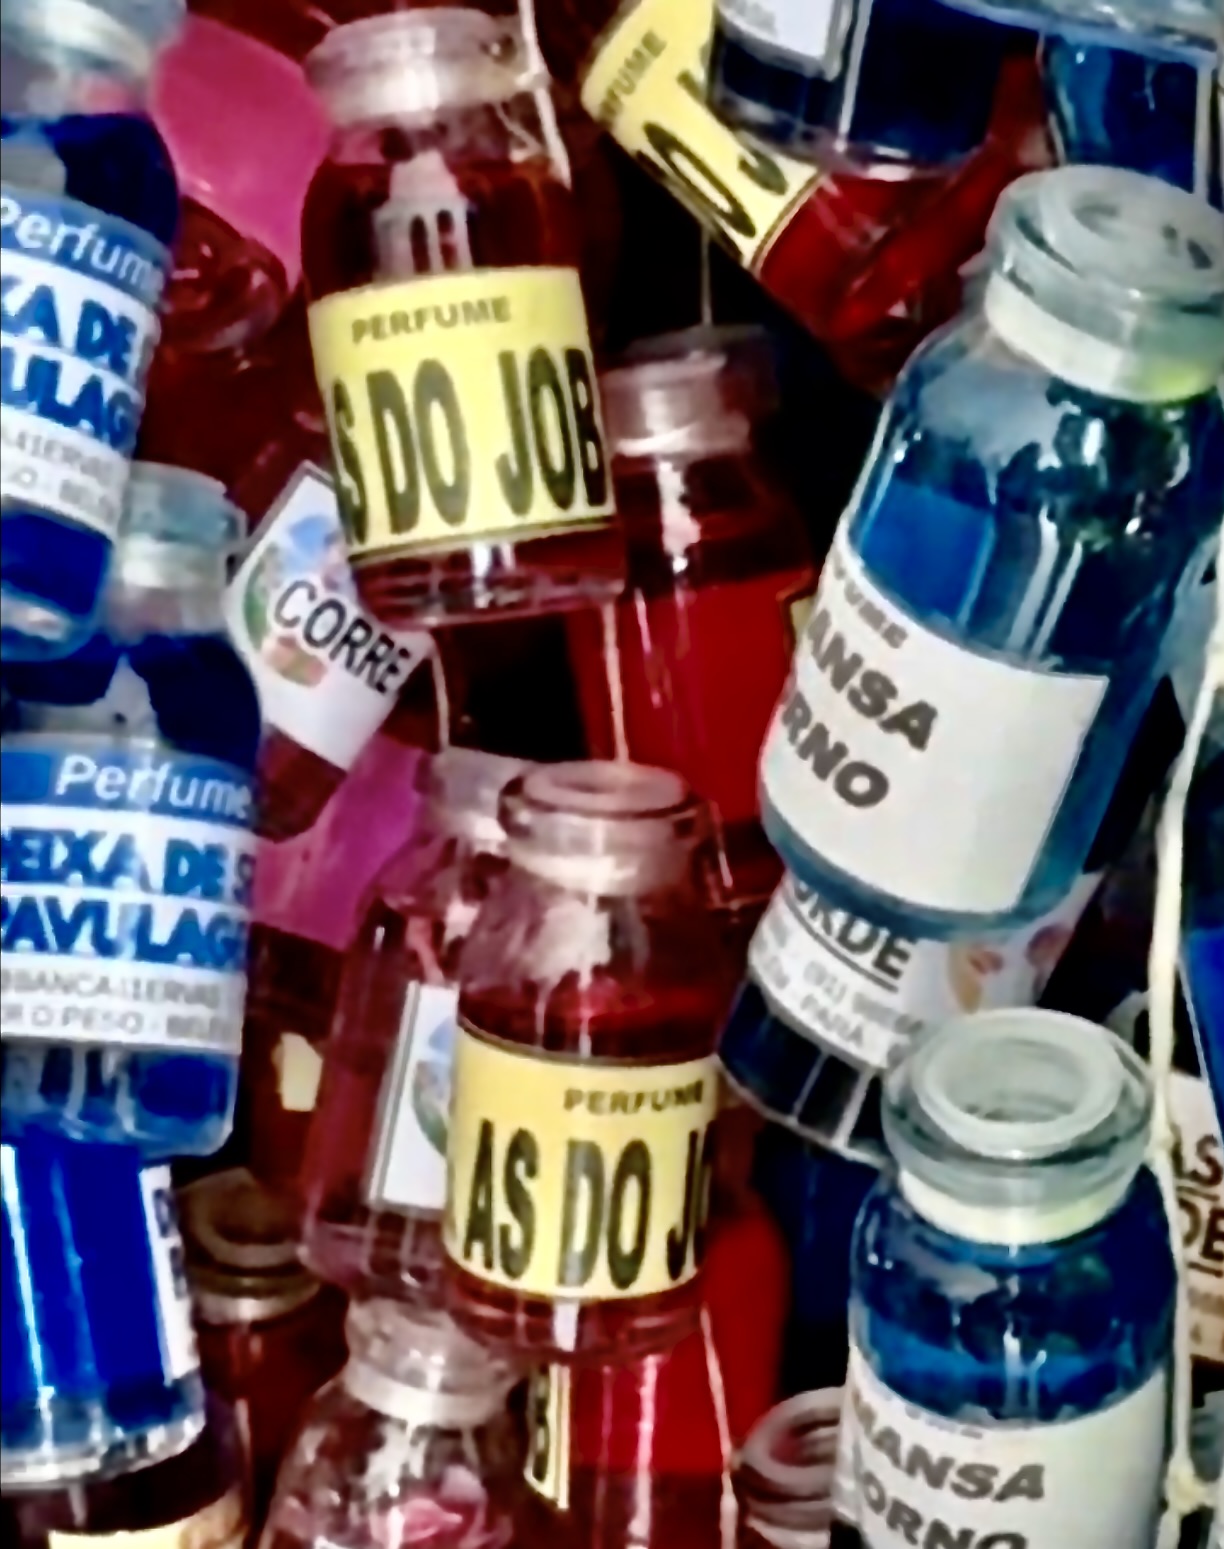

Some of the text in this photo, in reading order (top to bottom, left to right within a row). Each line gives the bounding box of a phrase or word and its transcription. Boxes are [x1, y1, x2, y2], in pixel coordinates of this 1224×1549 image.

[77, 299, 138, 378] DE
[352, 296, 512, 344] PERFUME
[366, 358, 471, 536] DO
[495, 345, 608, 518] JOB
[274, 579, 410, 695] CORRE
[0, 826, 153, 895] EIXA
[164, 837, 228, 898] DE
[0, 895, 246, 971] AVULAG
[464, 1118, 540, 1280] AS
[556, 1137, 655, 1291] DO
